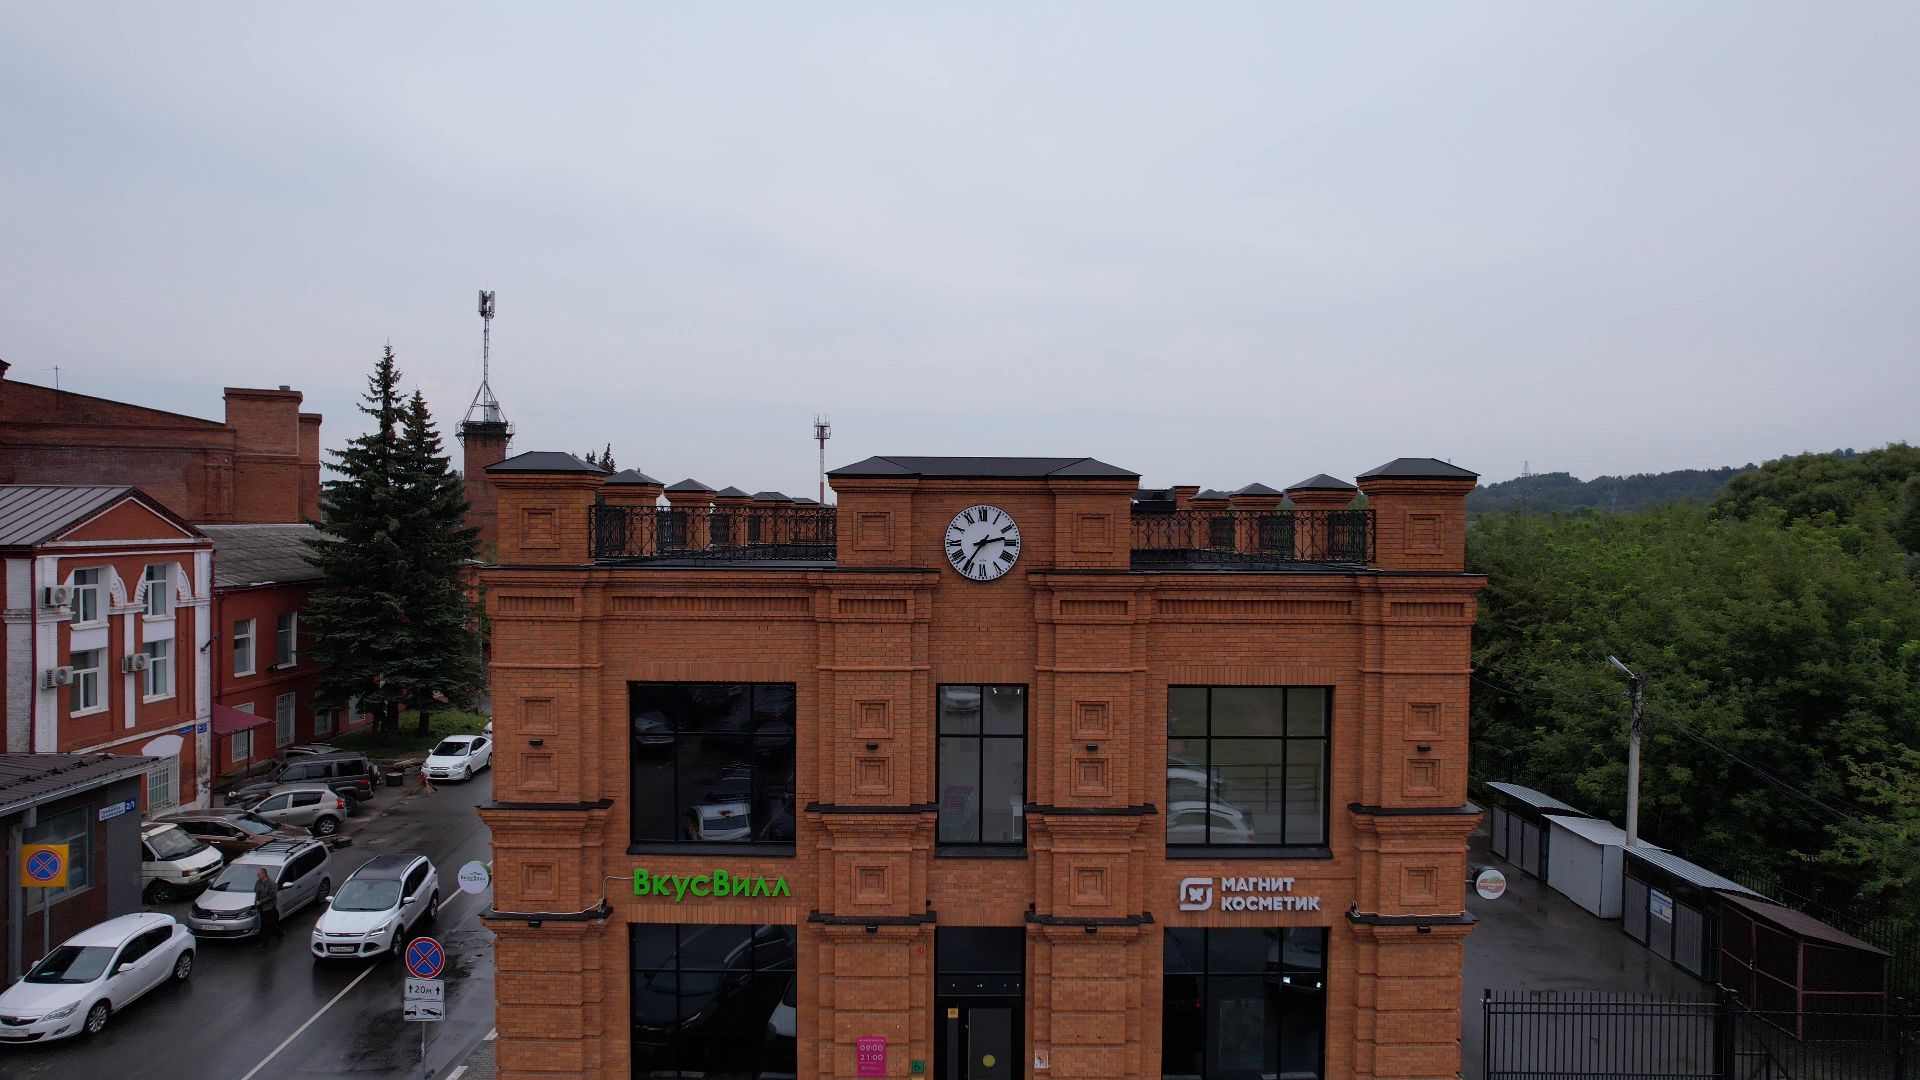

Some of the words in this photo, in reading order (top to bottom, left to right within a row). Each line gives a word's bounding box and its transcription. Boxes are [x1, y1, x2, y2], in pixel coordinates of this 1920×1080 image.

[633, 868, 791, 904] ВкусВилл
[1221, 877, 1295, 892] МАГНИТ
[1221, 896, 1321, 911] КОСМЕТИК
[860, 1044, 884, 1052] 09:00
